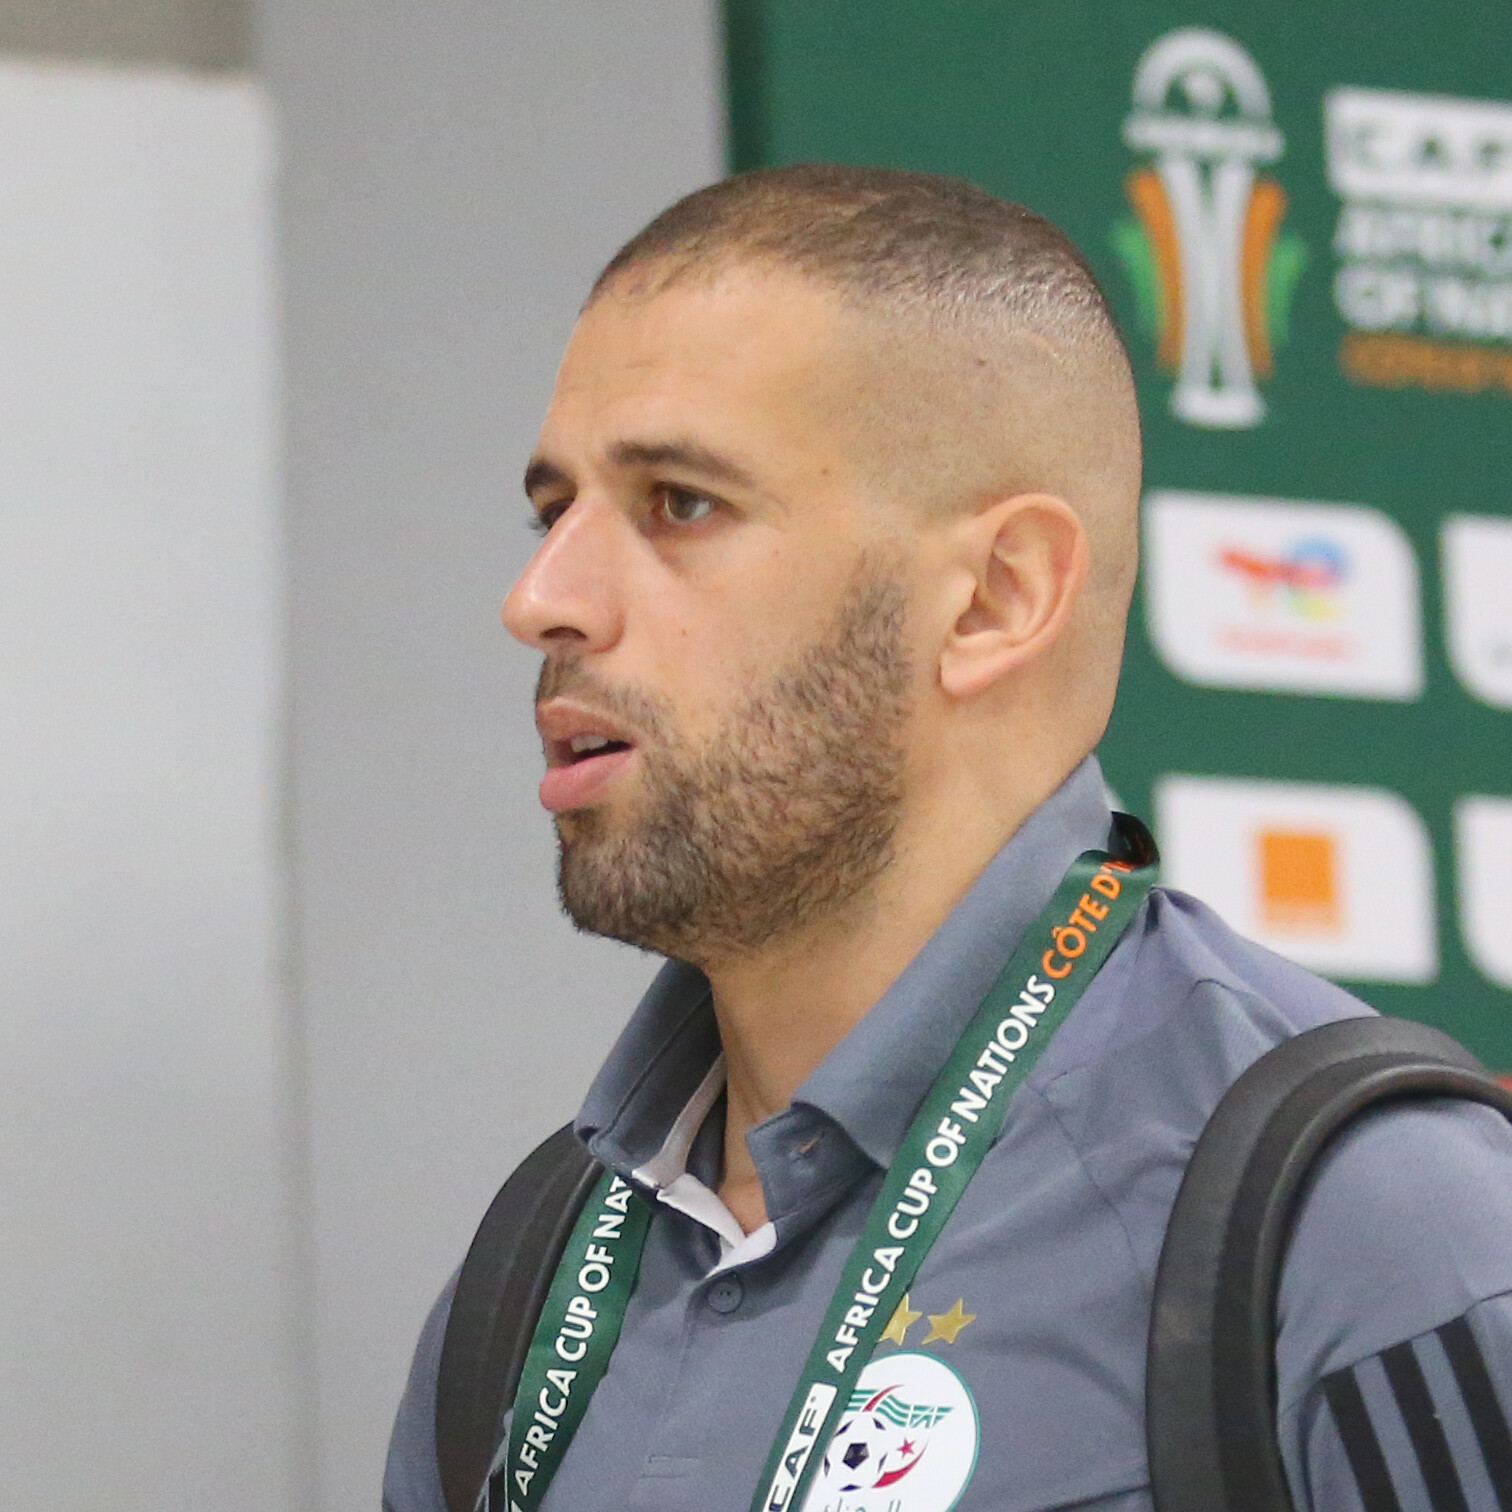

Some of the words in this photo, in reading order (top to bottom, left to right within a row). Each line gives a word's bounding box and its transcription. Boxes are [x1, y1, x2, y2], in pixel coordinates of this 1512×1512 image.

[826, 1246, 905, 1373] AFRICA
[888, 1167, 938, 1239] CUP
[925, 1116, 967, 1167] OF
[950, 975, 1055, 1123] NATIONS
[1041, 893, 1110, 979] CÔTE
[514, 1369, 577, 1496] AFRICA
[555, 1296, 598, 1362] CUP
[578, 1244, 615, 1292] OF
